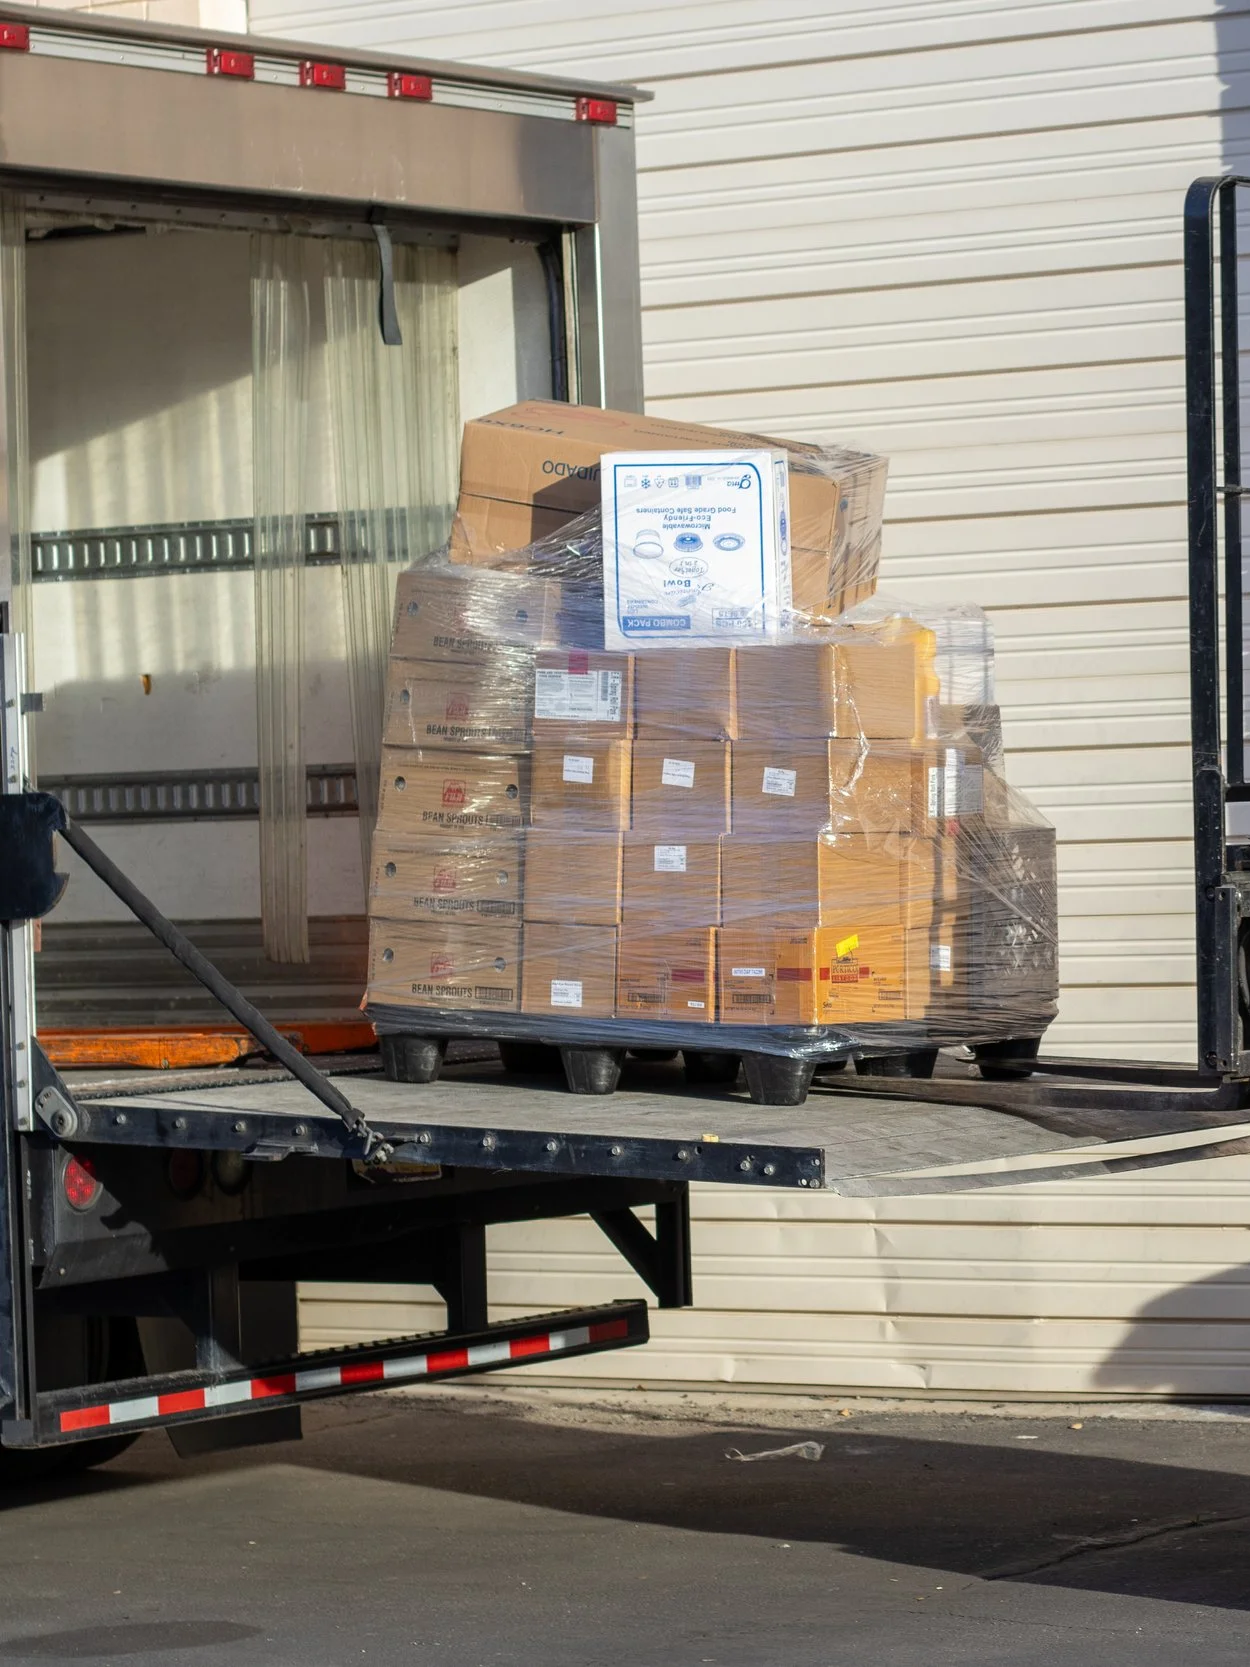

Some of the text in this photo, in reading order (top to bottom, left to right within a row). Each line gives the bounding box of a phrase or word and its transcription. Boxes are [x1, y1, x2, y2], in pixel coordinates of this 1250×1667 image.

[663, 579, 691, 587] Bowl
[628, 618, 686, 627] COMBO PACK
[433, 636, 455, 649] BEAN
[426, 724, 449, 737] BEAN
[423, 811, 484, 826] BEAN SPROUTS
[413, 896, 475, 911] BEAN SPROUTS
[411, 983, 473, 998] BEAN SPROUTS
